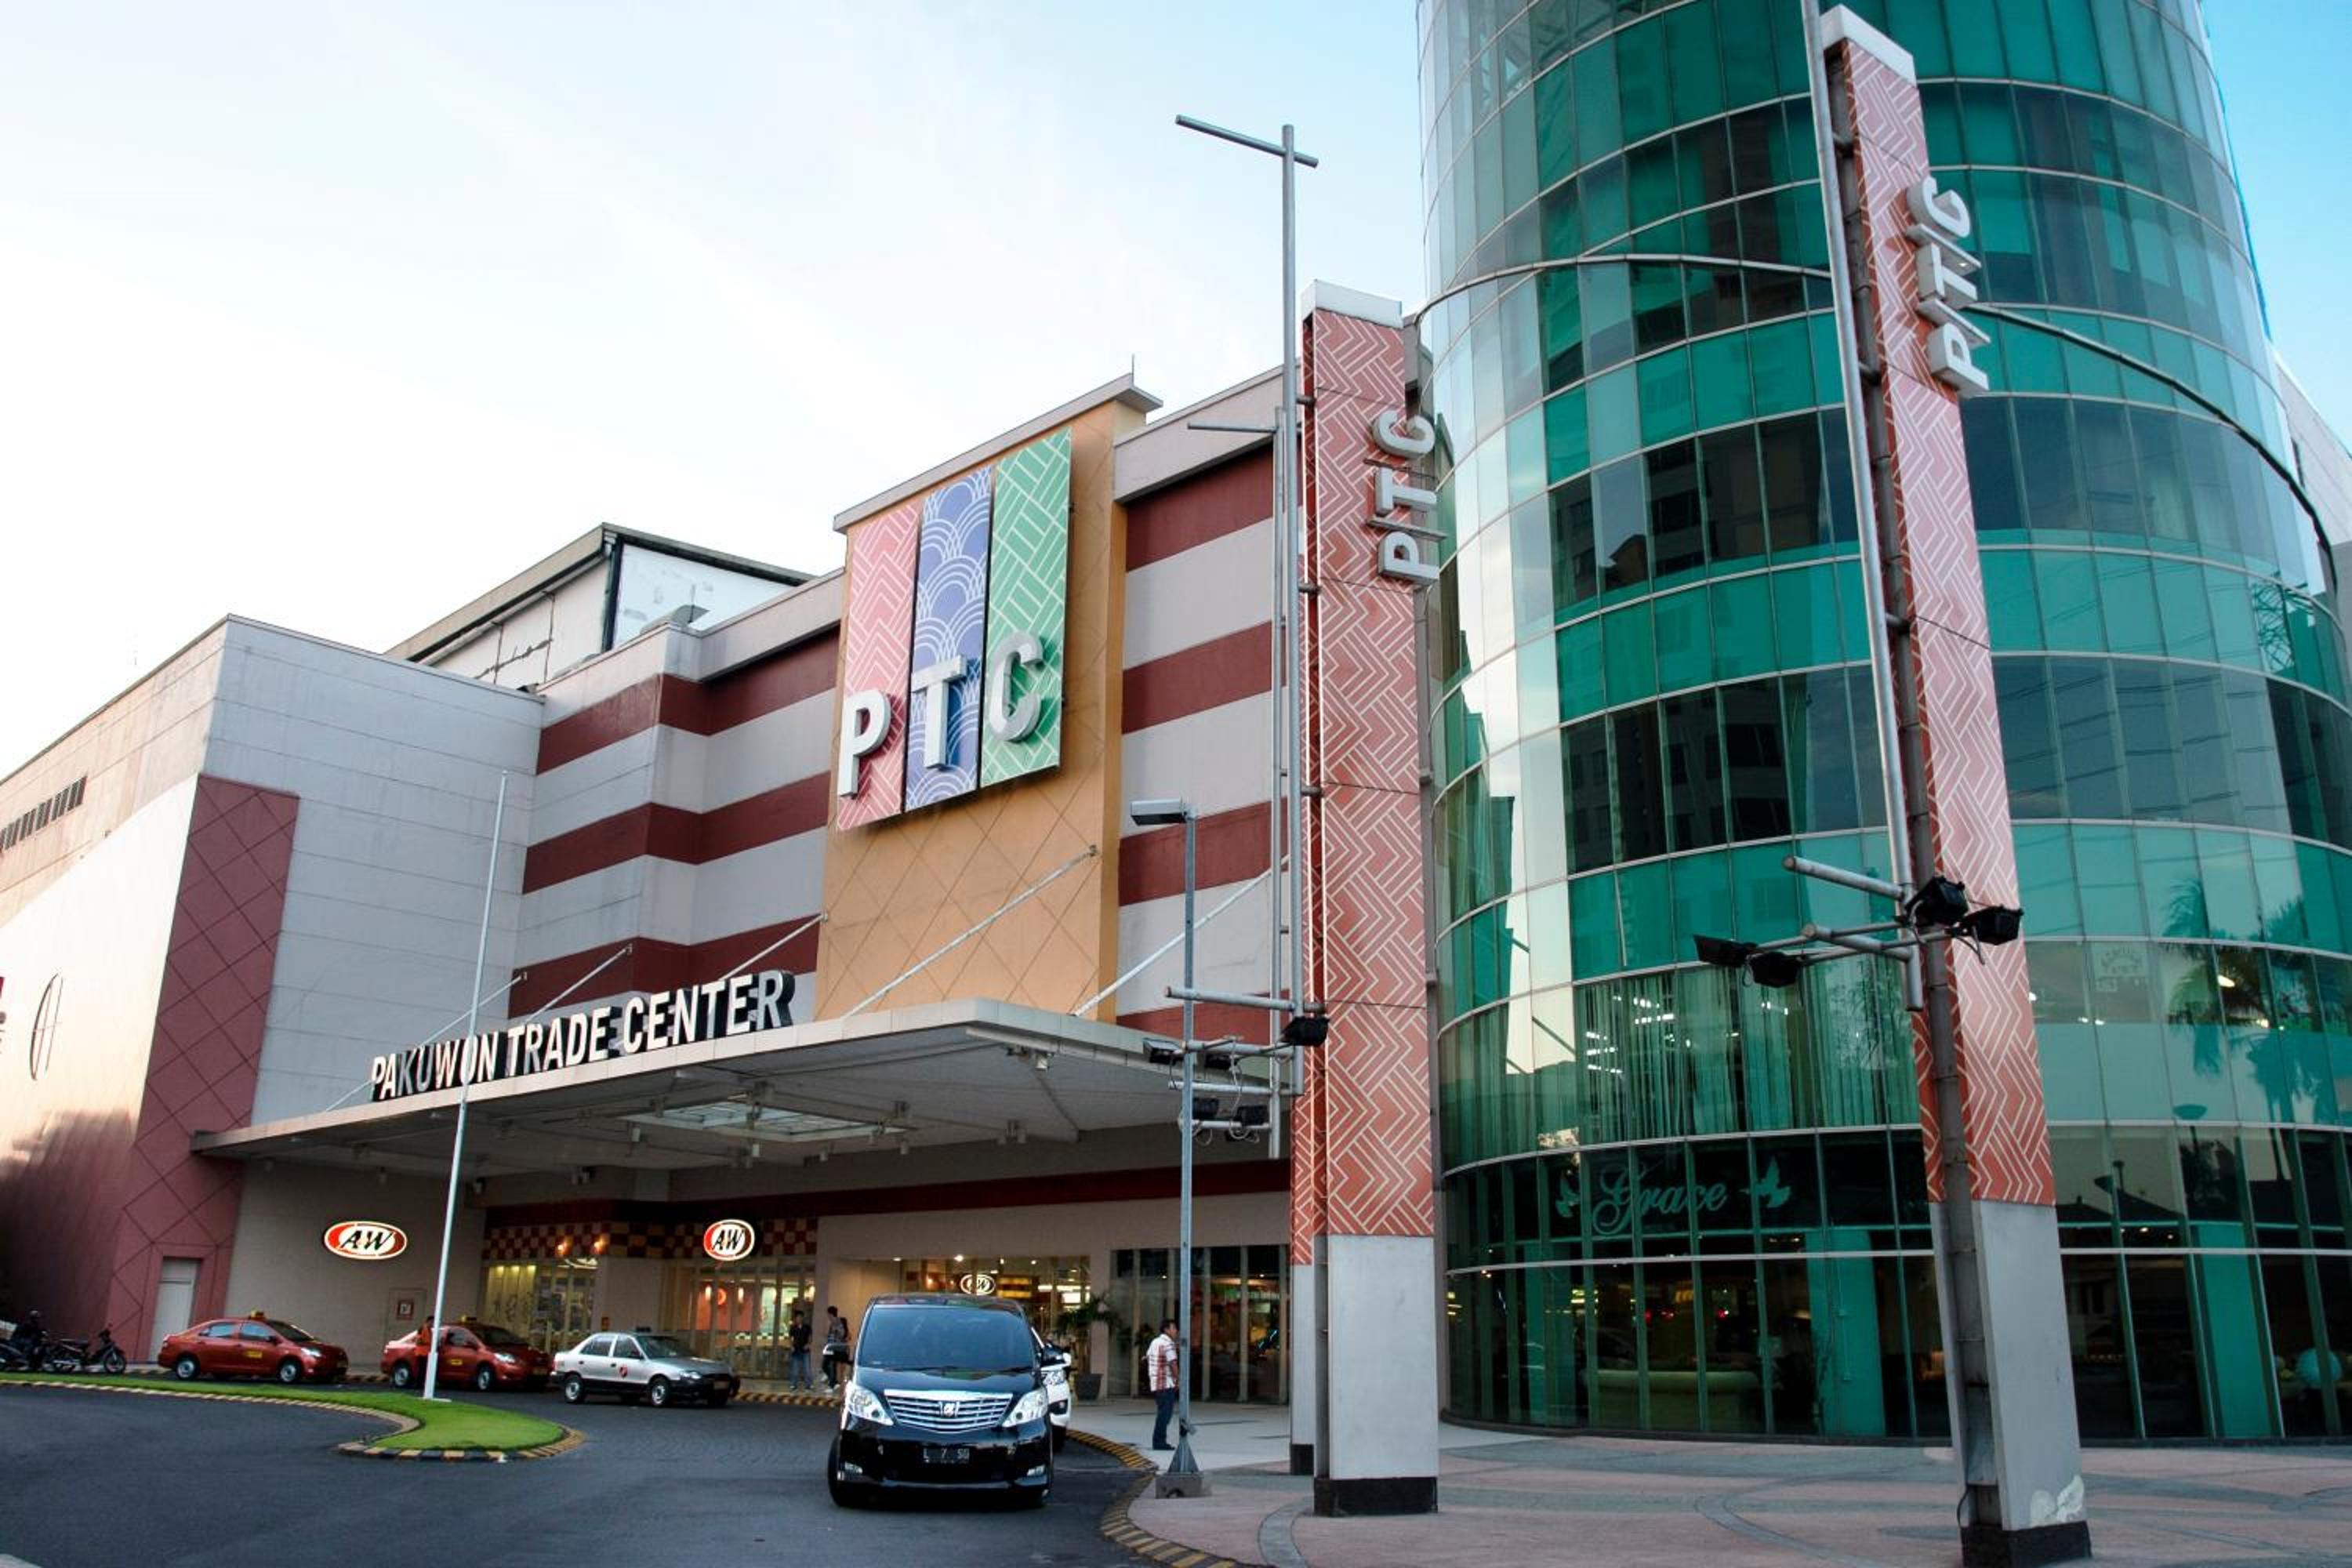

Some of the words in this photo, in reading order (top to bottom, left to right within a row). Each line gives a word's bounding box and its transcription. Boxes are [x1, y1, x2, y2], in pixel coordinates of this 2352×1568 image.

[1911, 176, 1990, 395] PTC
[1372, 408, 1438, 583] PTC
[837, 630, 1045, 798] PTC
[371, 1031, 499, 1101] PAKUWON
[506, 1007, 614, 1077] TRADE
[622, 969, 789, 1054] CENTER
